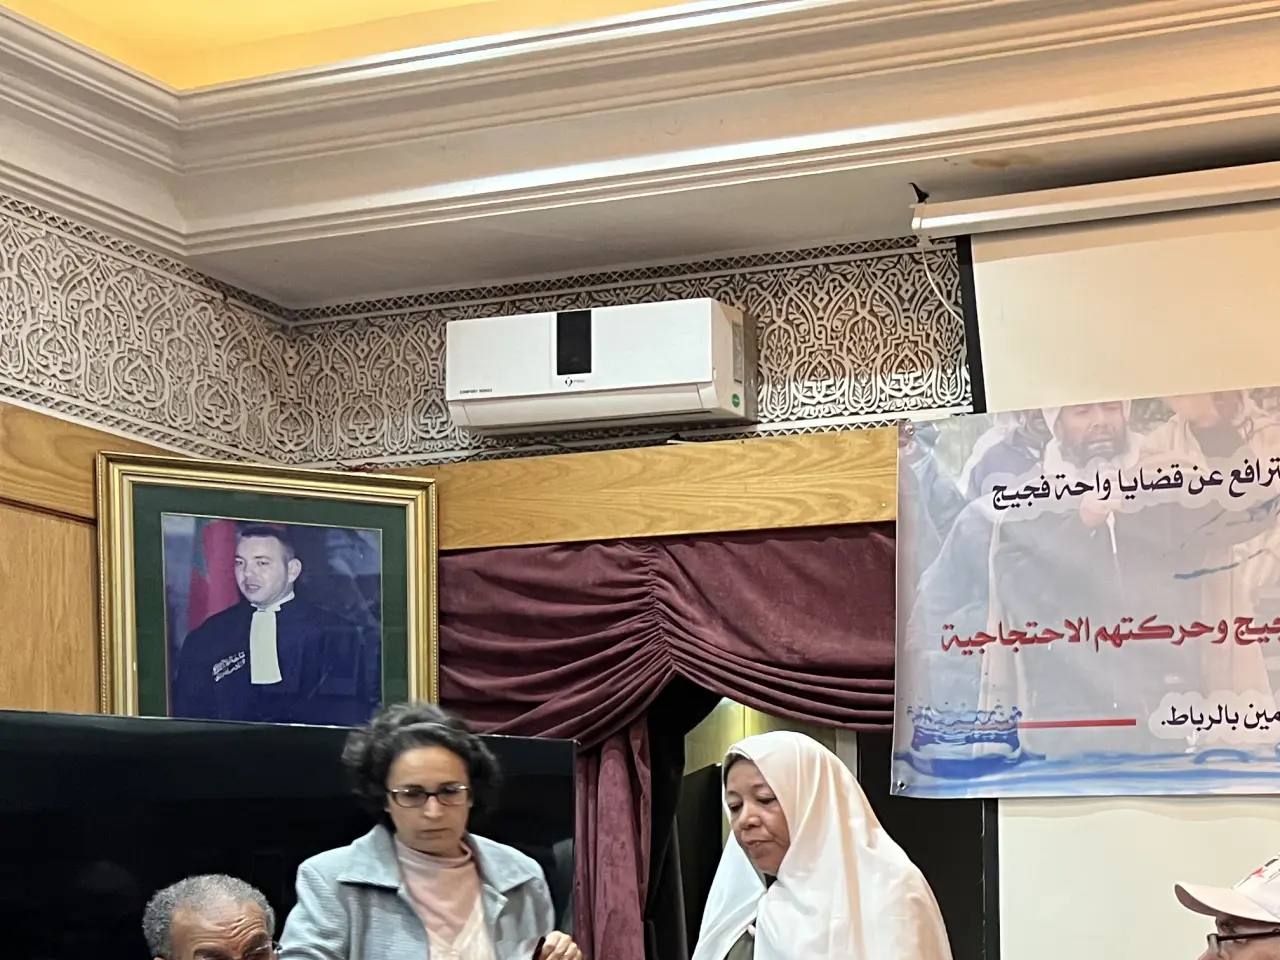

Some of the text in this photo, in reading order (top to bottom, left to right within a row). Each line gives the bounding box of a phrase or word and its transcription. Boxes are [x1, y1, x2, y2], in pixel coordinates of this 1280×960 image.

[992, 475, 1051, 510] فجيج
[1055, 469, 1111, 500] واحة
[1118, 463, 1184, 500] قضايا
[1188, 465, 1223, 494] عن
[941, 615, 1090, 656] الاحتجاجية
[1093, 614, 1228, 652] وحركتهم
